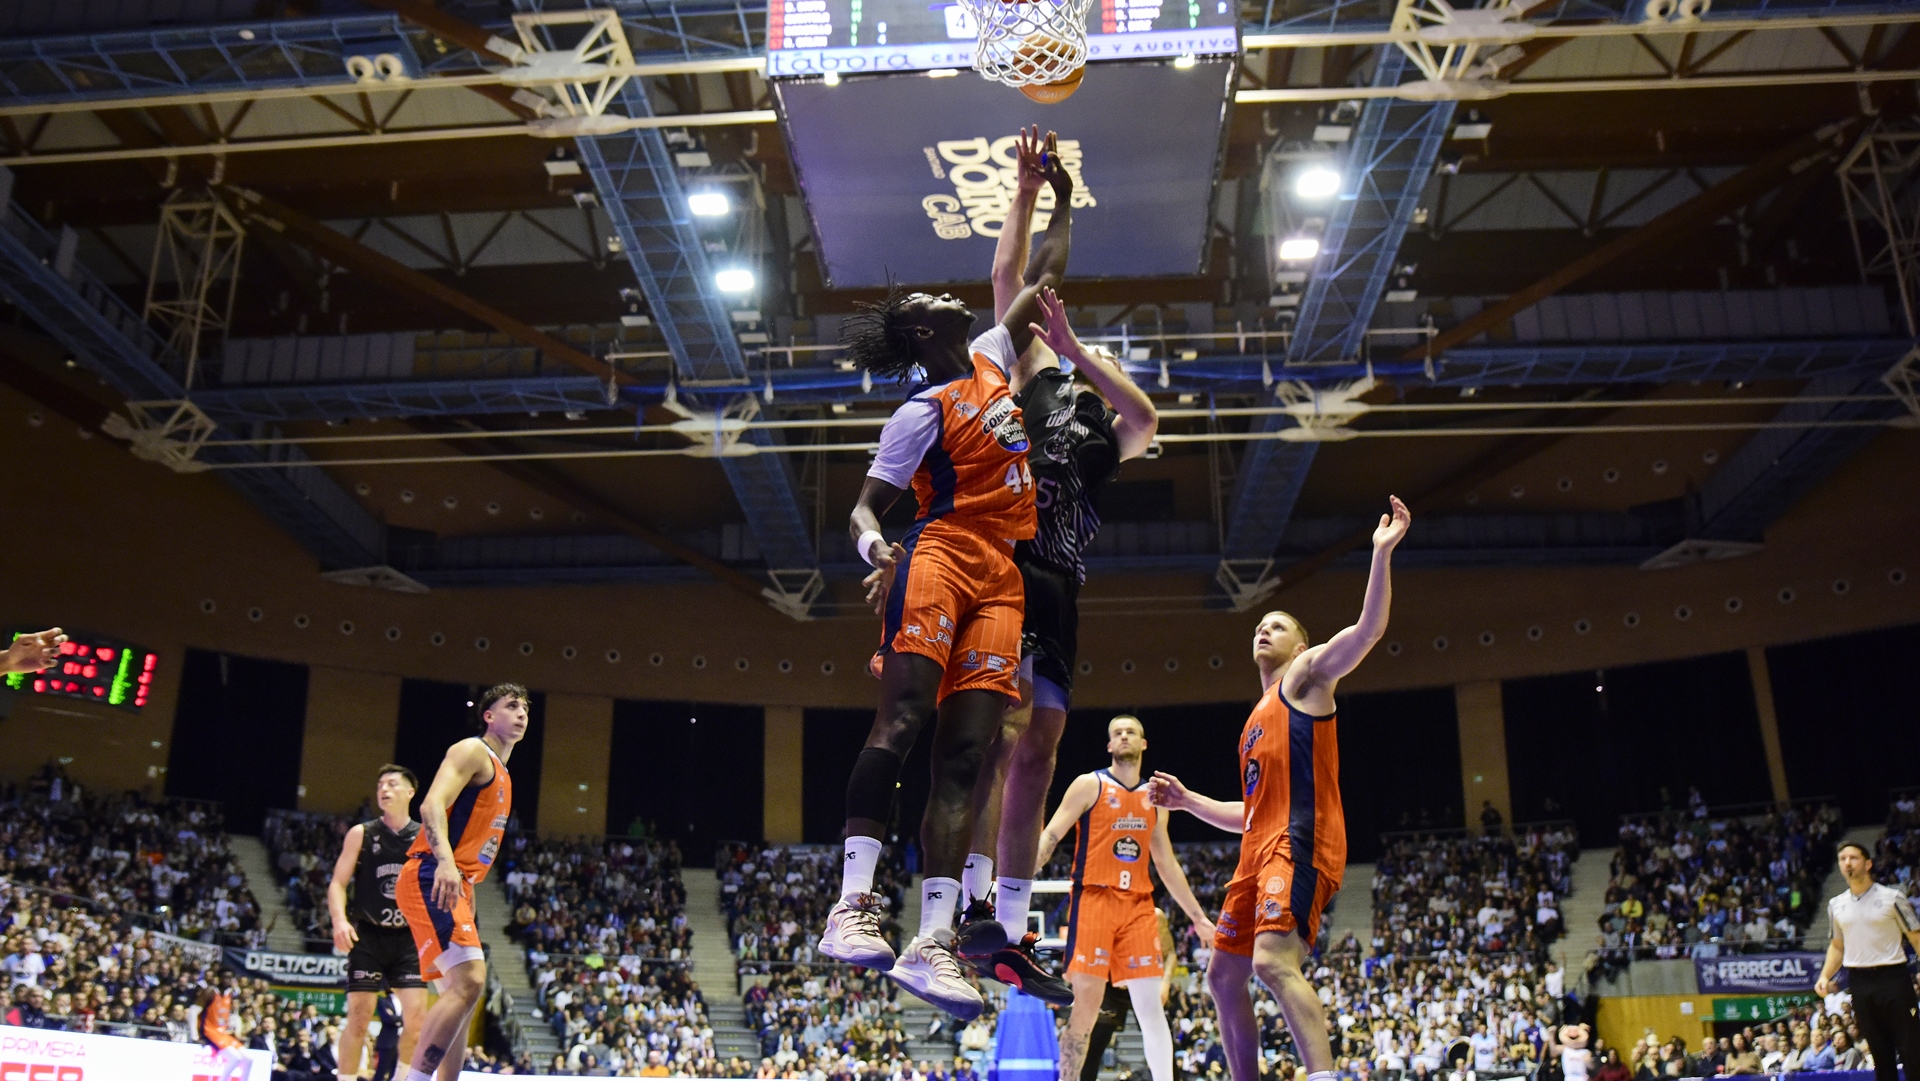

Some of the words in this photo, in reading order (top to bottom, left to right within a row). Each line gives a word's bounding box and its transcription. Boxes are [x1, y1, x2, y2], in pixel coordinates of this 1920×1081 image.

[956, 13, 966, 30] 4
[1133, 37, 1235, 53] AUDITIVO
[921, 194, 972, 240] CAB
[1004, 461, 1033, 494] 44
[1119, 870, 1132, 889] 8
[928, 891, 942, 900] PG
[381, 908, 404, 927] 28
[1718, 958, 1808, 979] FERRECAL
[2, 1036, 86, 1058] PRIMERA
